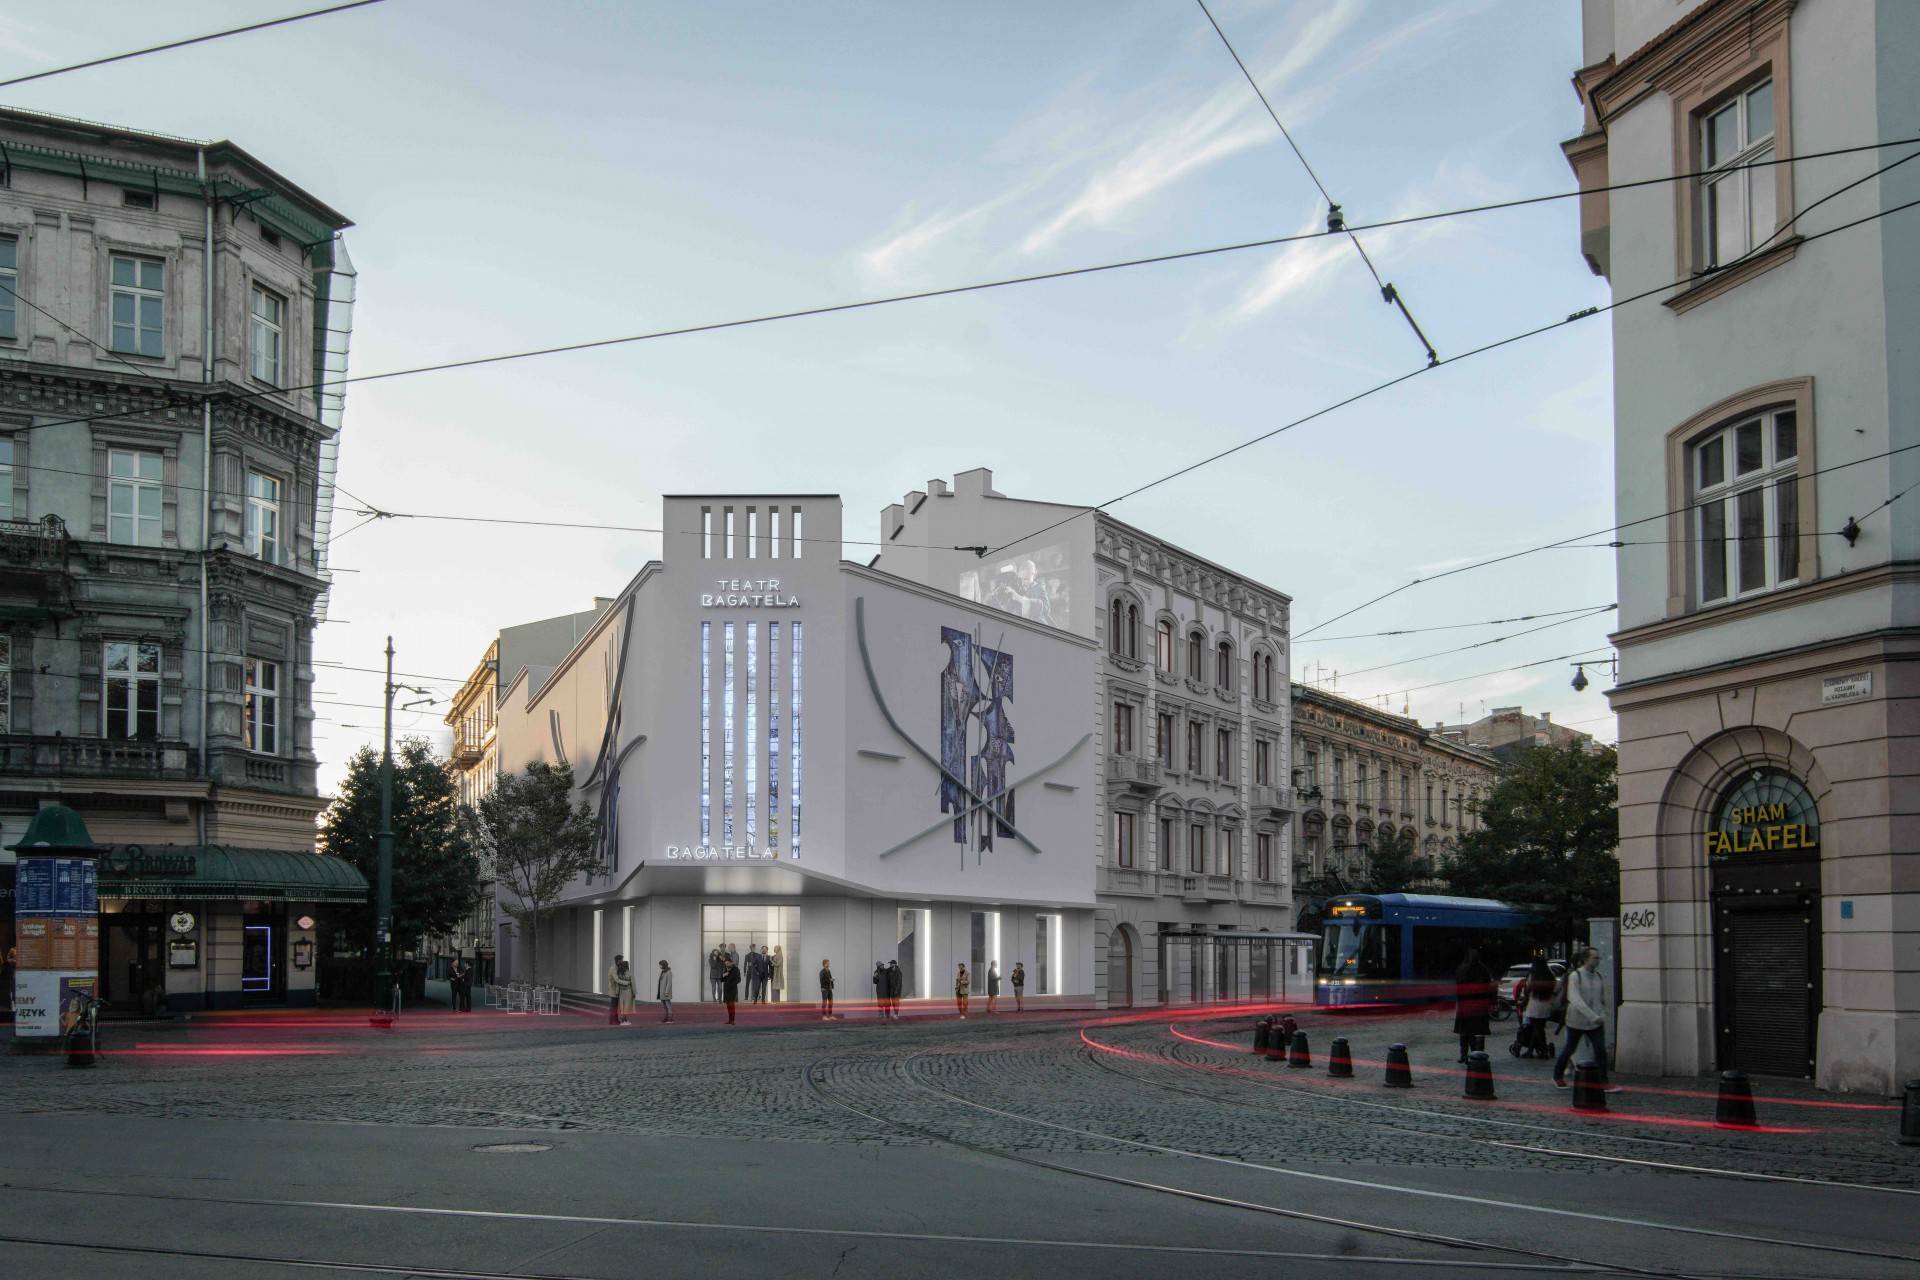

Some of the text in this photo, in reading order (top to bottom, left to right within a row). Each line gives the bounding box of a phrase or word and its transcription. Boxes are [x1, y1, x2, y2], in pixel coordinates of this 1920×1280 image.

[717, 579, 780, 591] TEATR
[701, 594, 801, 607] BAGATELA
[1730, 804, 1785, 825] SHAM
[1704, 824, 1816, 854] FALAFEL
[666, 846, 774, 859] BAGATELA
[124, 887, 173, 896] BROWAR
